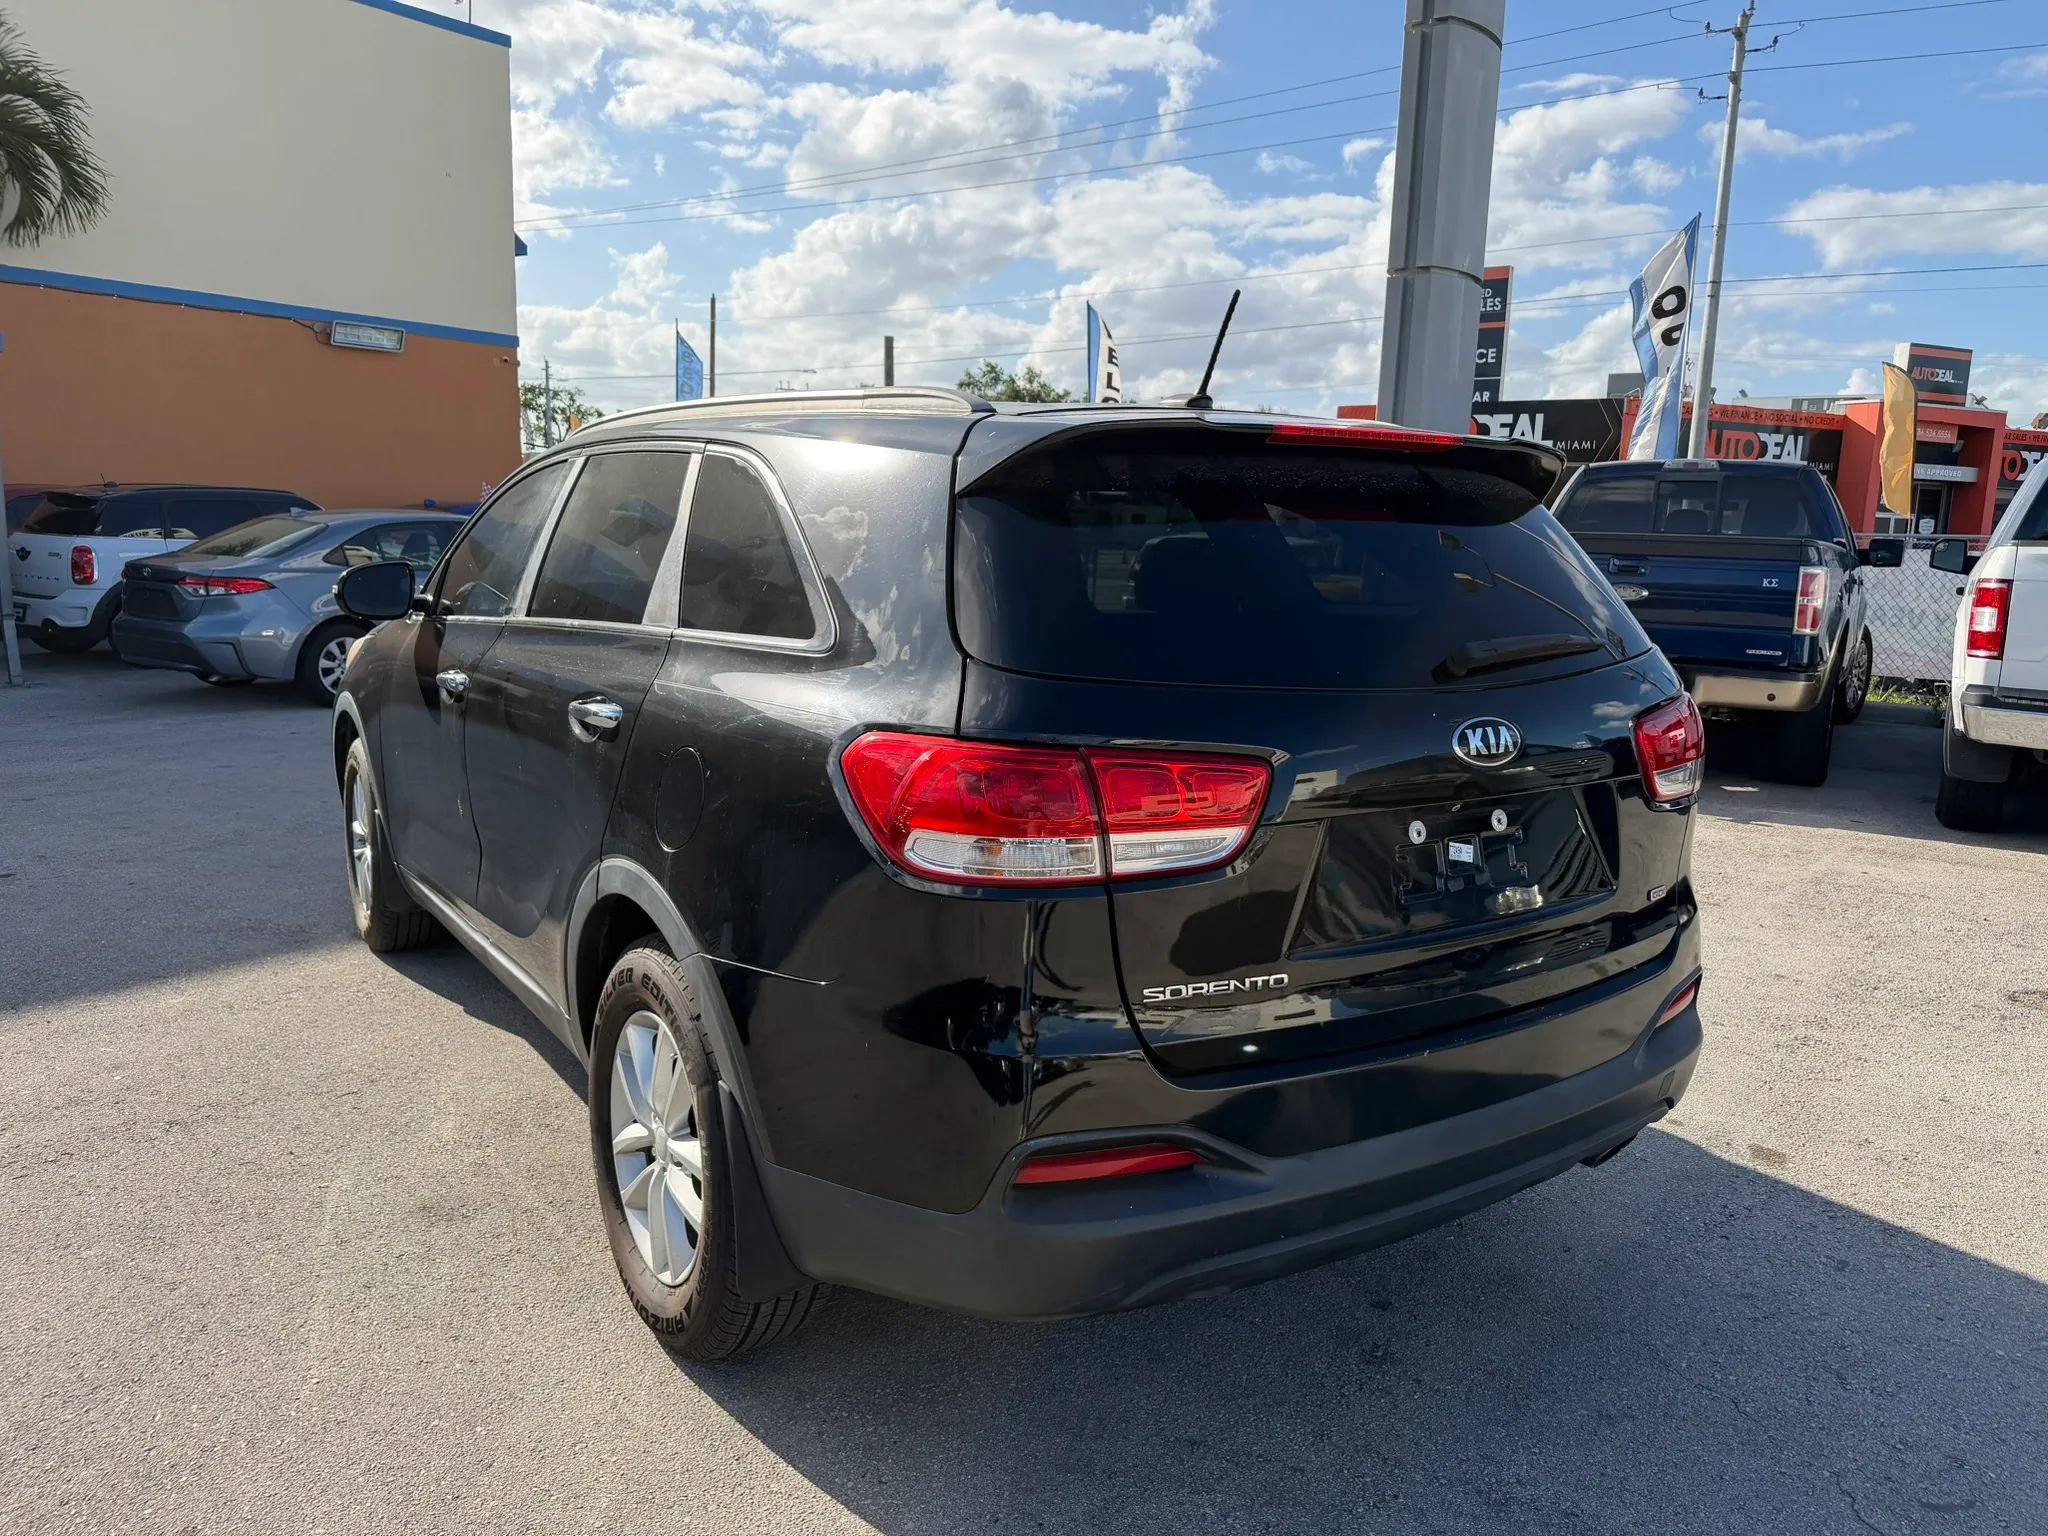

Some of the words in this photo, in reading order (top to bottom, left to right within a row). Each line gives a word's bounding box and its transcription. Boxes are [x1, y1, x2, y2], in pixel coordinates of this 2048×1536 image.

[1481, 288, 1492, 298] ED
[1480, 298, 1501, 311] LES
[1475, 348, 1497, 364] CE
[1911, 367, 1954, 382] AUTODEAL
[1472, 391, 1490, 403] AR
[1470, 413, 1553, 447] DEAL
[1556, 440, 1596, 449] MIAMI
[1465, 726, 1514, 755] KIA
[1142, 973, 1289, 1003] SORENTO
